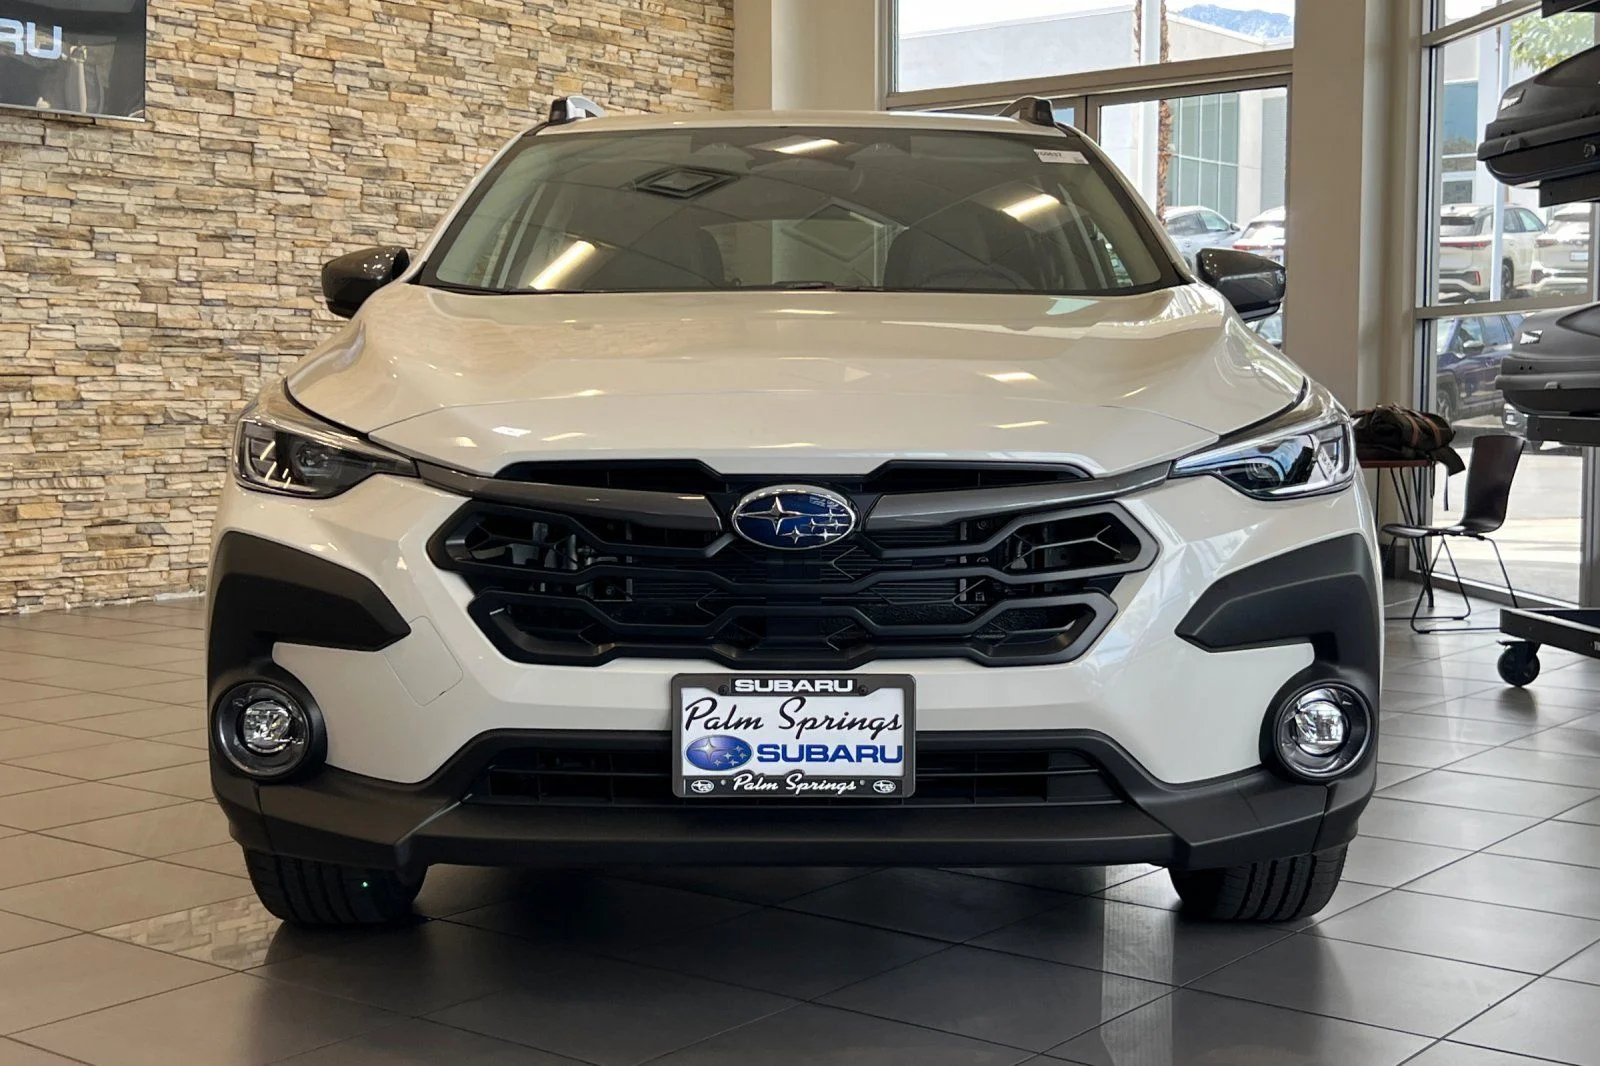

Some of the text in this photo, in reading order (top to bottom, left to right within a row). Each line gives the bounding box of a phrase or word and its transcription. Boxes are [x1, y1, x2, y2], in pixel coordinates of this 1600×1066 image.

[734, 679, 854, 693] SUBARU
[684, 695, 902, 740] Palm Springs
[757, 743, 903, 763] SUBARU
[733, 773, 857, 794] Palm Springs
